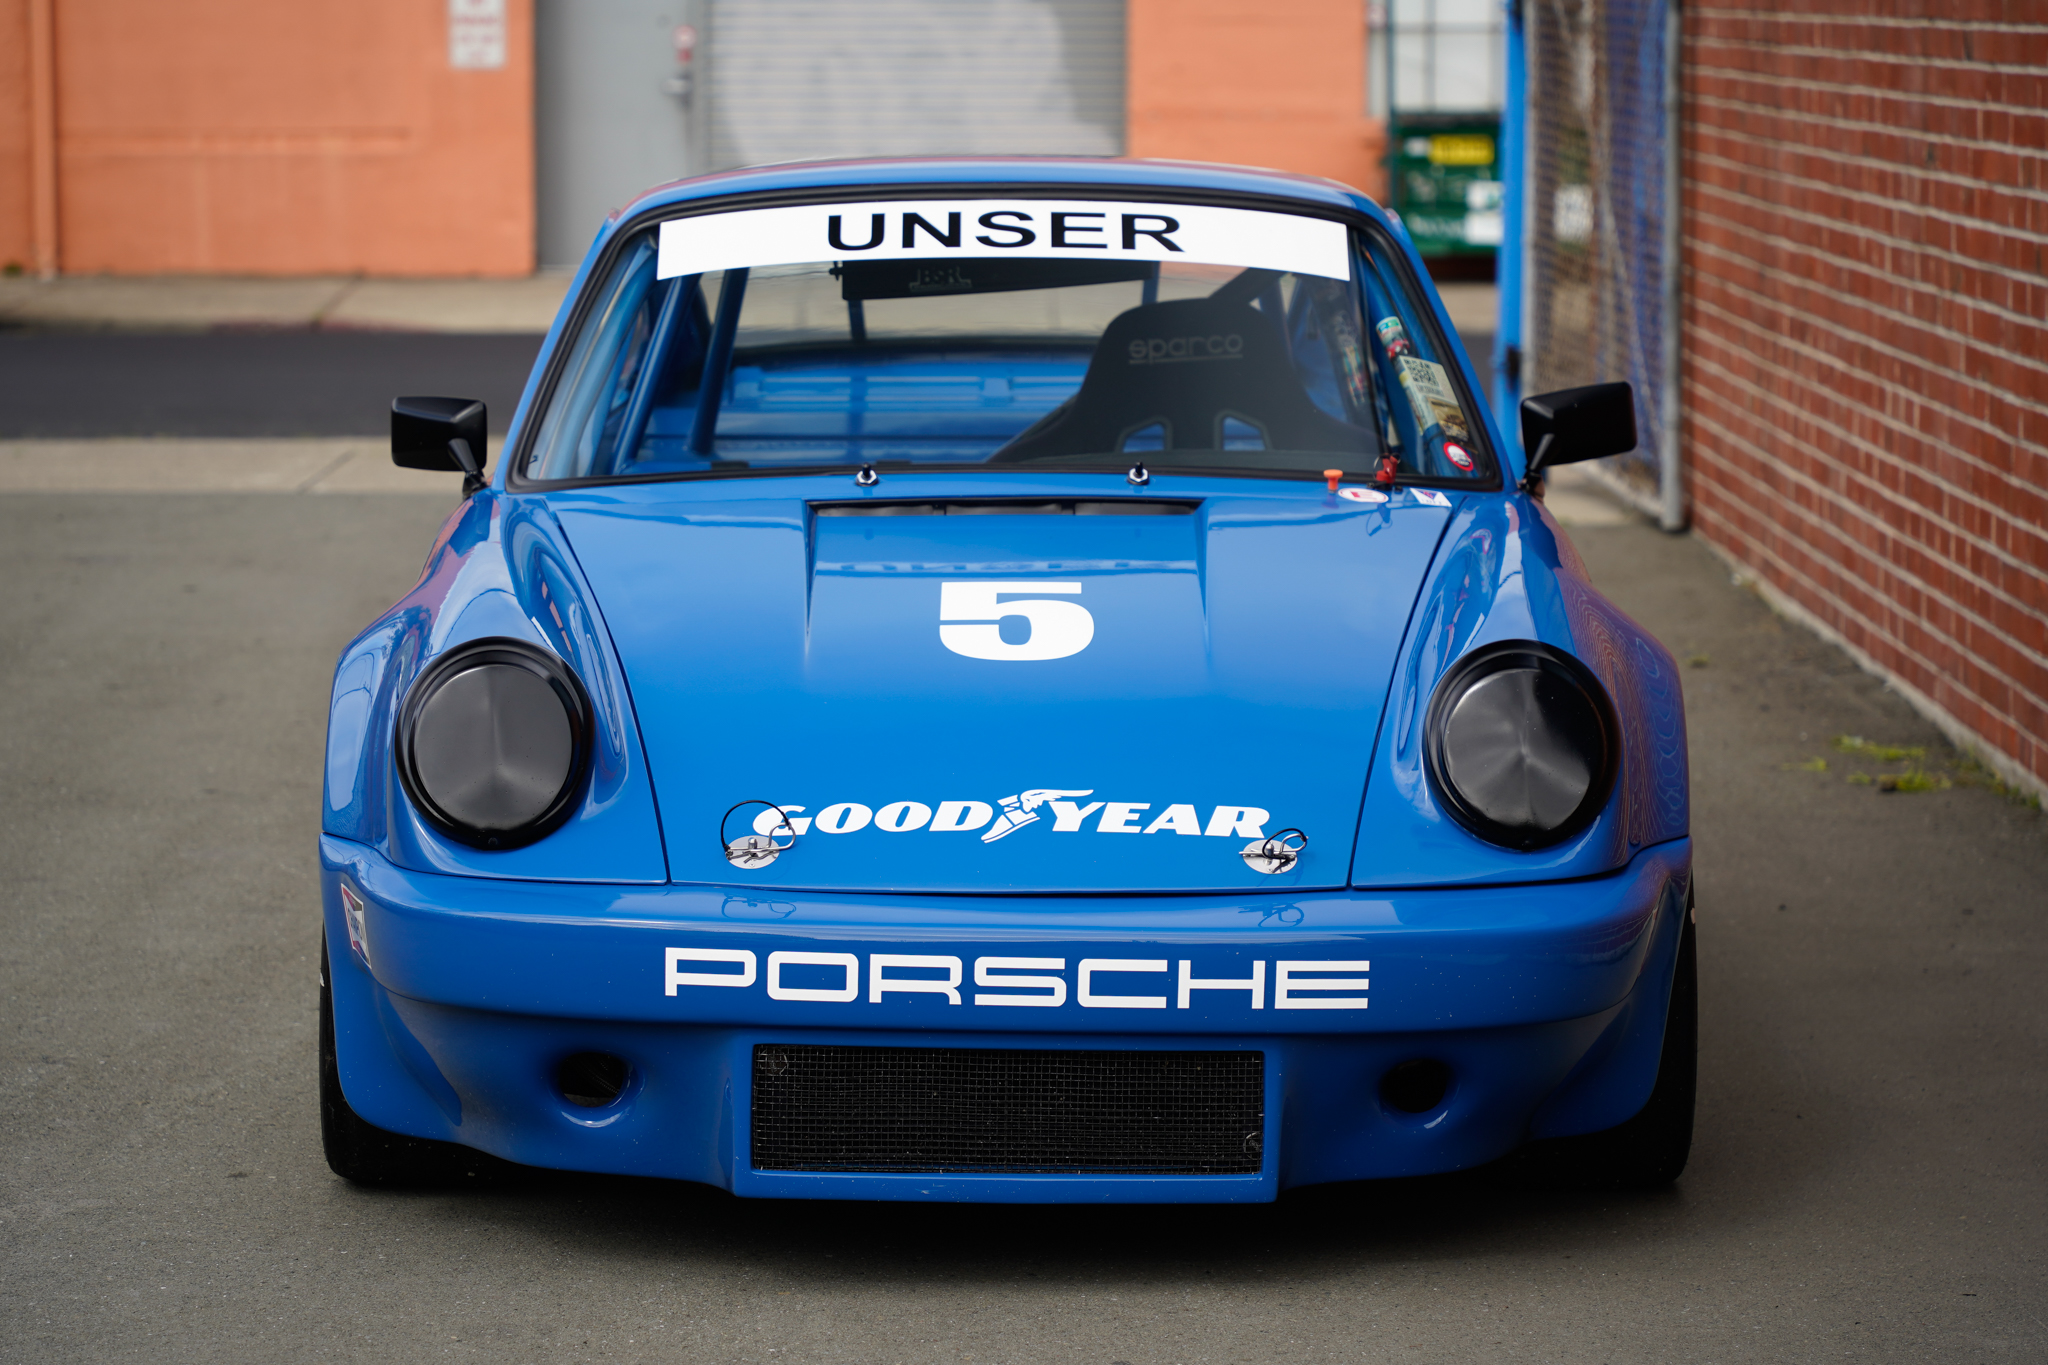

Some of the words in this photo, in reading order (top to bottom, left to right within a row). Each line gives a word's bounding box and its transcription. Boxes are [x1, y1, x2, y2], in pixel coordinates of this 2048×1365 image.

[827, 210, 1186, 252] UNSER
[1128, 333, 1244, 365] sparco
[939, 581, 1095, 661] 5
[664, 947, 1370, 1010] PORSCHE
